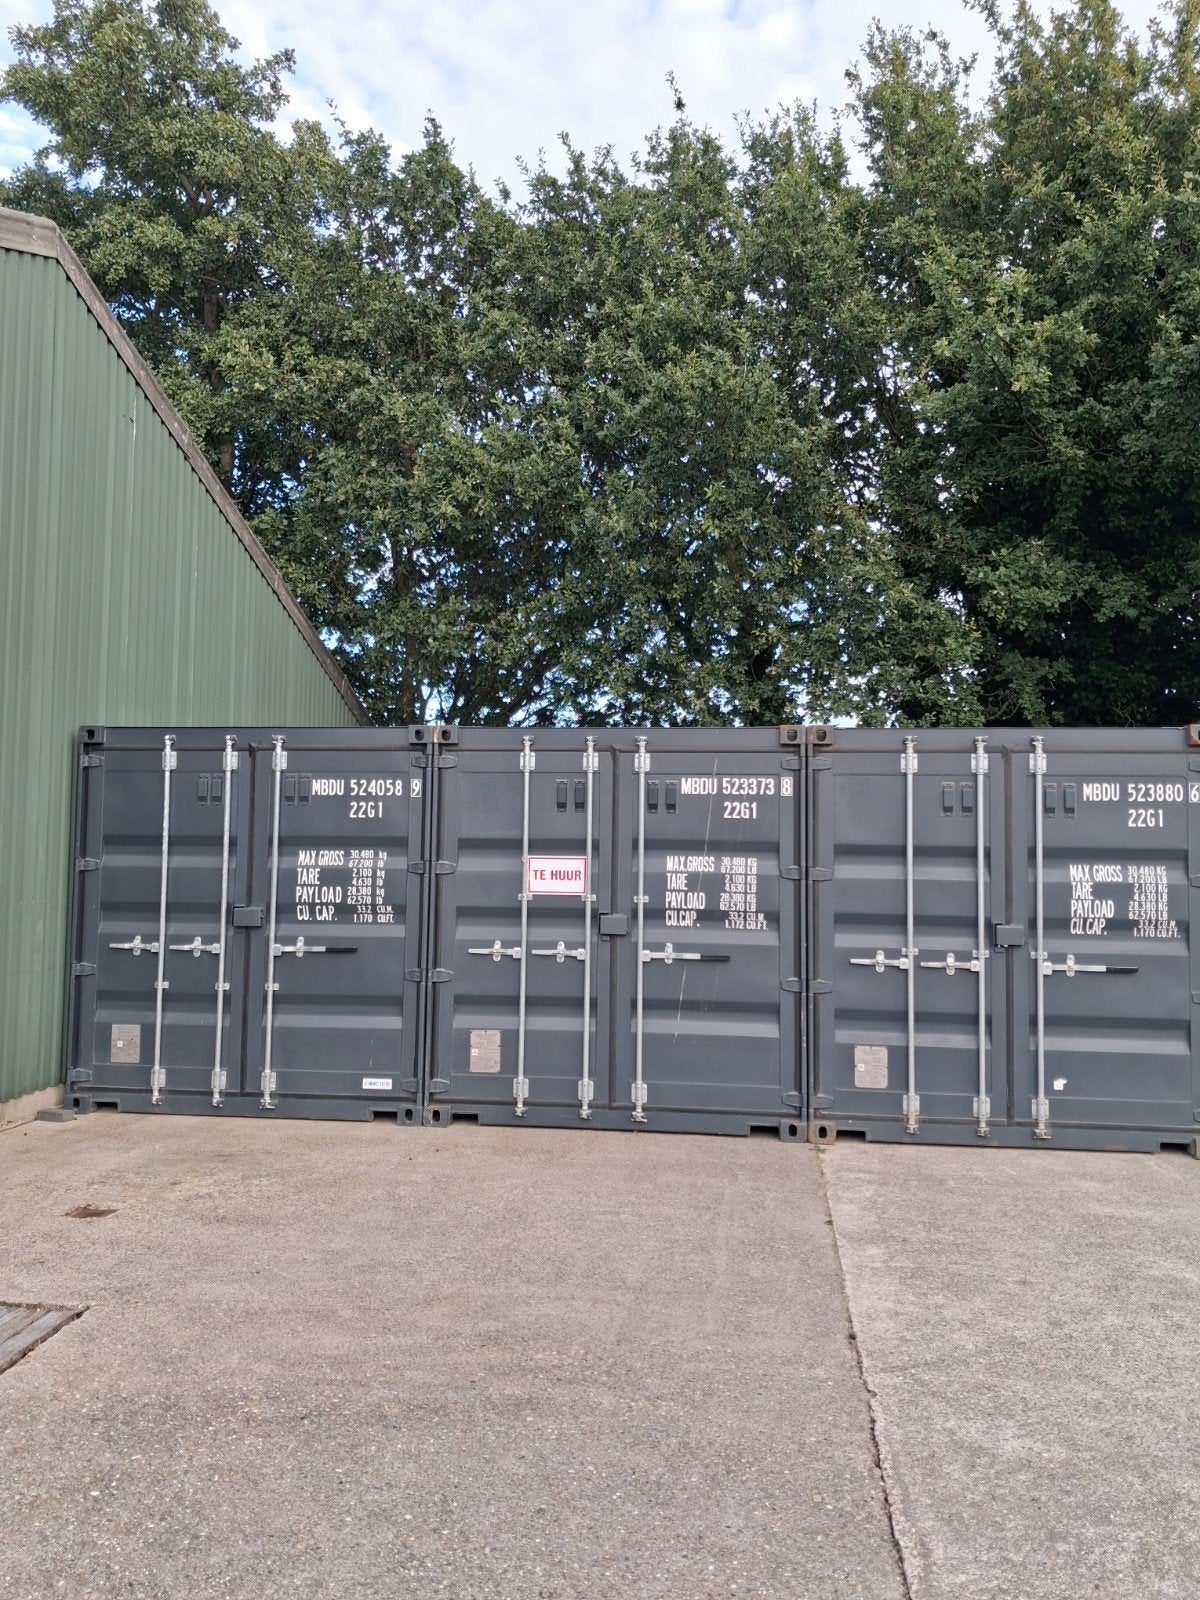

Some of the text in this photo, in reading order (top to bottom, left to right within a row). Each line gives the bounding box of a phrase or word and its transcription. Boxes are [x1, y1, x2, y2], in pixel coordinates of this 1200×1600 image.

[312, 779, 345, 796] MBDU
[350, 779, 403, 796] 524058
[681, 777, 718, 795] MBDU
[722, 777, 775, 795] 523373
[1083, 783, 1200, 802] MBDU 523880 6
[349, 801, 383, 818] 22G1
[723, 801, 757, 819] 22G1
[1128, 809, 1163, 827] 22G1
[298, 850, 345, 866] MAX GROSS
[379, 850, 387, 860] kg
[377, 860, 384, 868] lb
[747, 858, 757, 867] KG
[376, 869, 385, 879] kg
[532, 869, 581, 881] TE HUUR
[747, 866, 757, 874] LB
[1070, 865, 1122, 882] MAX GROSS
[1157, 866, 1166, 875] KG
[297, 868, 320, 885] TARE
[666, 873, 688, 890] TARE
[747, 875, 757, 884] KG
[1158, 875, 1167, 884] LB
[376, 878, 383, 886] lb
[376, 887, 384, 898] kg
[747, 884, 757, 892] LB
[1071, 882, 1093, 899] TARE
[1158, 884, 1168, 892] KG
[295, 886, 342, 903] PAYLOAD
[747, 894, 757, 902] KG
[1158, 893, 1167, 902] LB
[376, 896, 383, 905] lb
[665, 892, 706, 909] PAYLOAD
[746, 903, 756, 911] LB
[1071, 900, 1115, 918] PAYLOAD
[1158, 902, 1168, 911] KG
[297, 905, 337, 921] CU. CAP.
[1158, 911, 1167, 920] LB
